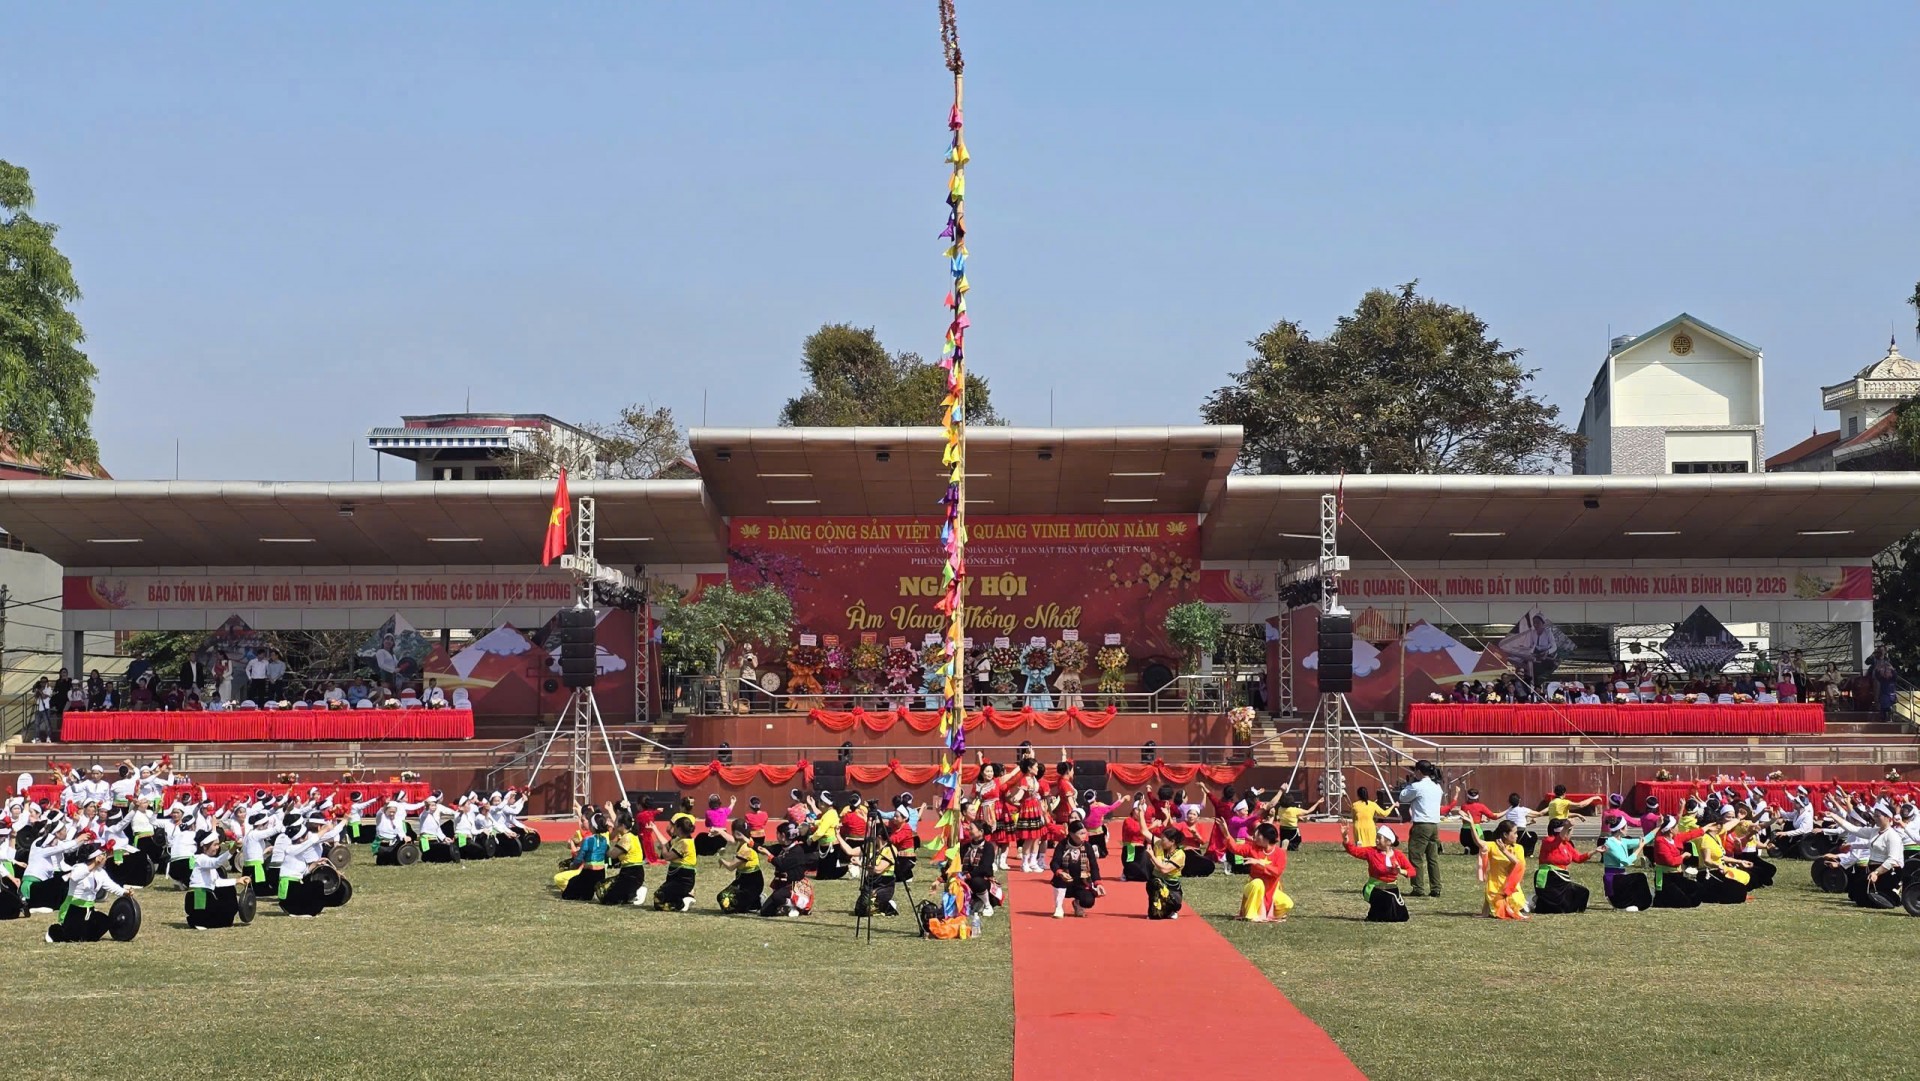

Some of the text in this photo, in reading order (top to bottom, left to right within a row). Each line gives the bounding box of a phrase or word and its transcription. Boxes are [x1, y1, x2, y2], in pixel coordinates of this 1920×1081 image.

[768, 518, 811, 540] ĐẢNG
[815, 521, 857, 543] CỘNG
[860, 518, 891, 540] SẢN
[895, 520, 931, 543] VIỆT
[973, 524, 1027, 540] QUANG
[1031, 523, 1071, 539] VINH
[1074, 519, 1119, 538] MUÔN
[1124, 519, 1159, 538] NĂM
[989, 554, 1016, 565] NHẤT
[1021, 546, 1037, 554] BAN
[1055, 544, 1078, 556] TRẬN
[1113, 544, 1131, 555] VIỆT
[1132, 545, 1151, 554] NAM
[148, 581, 170, 602] BẢO
[198, 581, 214, 602] VÀ
[216, 581, 244, 602] PHÁT
[247, 585, 270, 602] HUY
[272, 581, 290, 602] GIÁ
[294, 584, 311, 605] TRỊ
[315, 581, 336, 602] VĂN
[340, 580, 362, 601] HÓA
[410, 578, 447, 601] THỐNG
[451, 580, 473, 600] CÁC
[476, 580, 498, 600] DÂN
[502, 580, 523, 604] TỘC
[526, 578, 571, 600] PHƯỜNG
[980, 572, 1028, 601] HỘI
[1363, 578, 1405, 597] QUANG
[1409, 578, 1442, 597] VINH,
[1446, 575, 1484, 596] MỪNG
[1487, 572, 1511, 595] ĐẤT
[1515, 574, 1550, 595] NƯỚC
[1553, 570, 1574, 595] ĐỔI
[1578, 573, 1606, 597] MỚI,
[1610, 573, 1649, 595] MỪNG
[1652, 573, 1687, 595] XUÂN
[1691, 572, 1721, 594] BÍNH
[1725, 577, 1752, 598] NGỌ
[1756, 576, 1787, 595] 2026
[845, 599, 1082, 635] Âm Vang Thống Nhất
